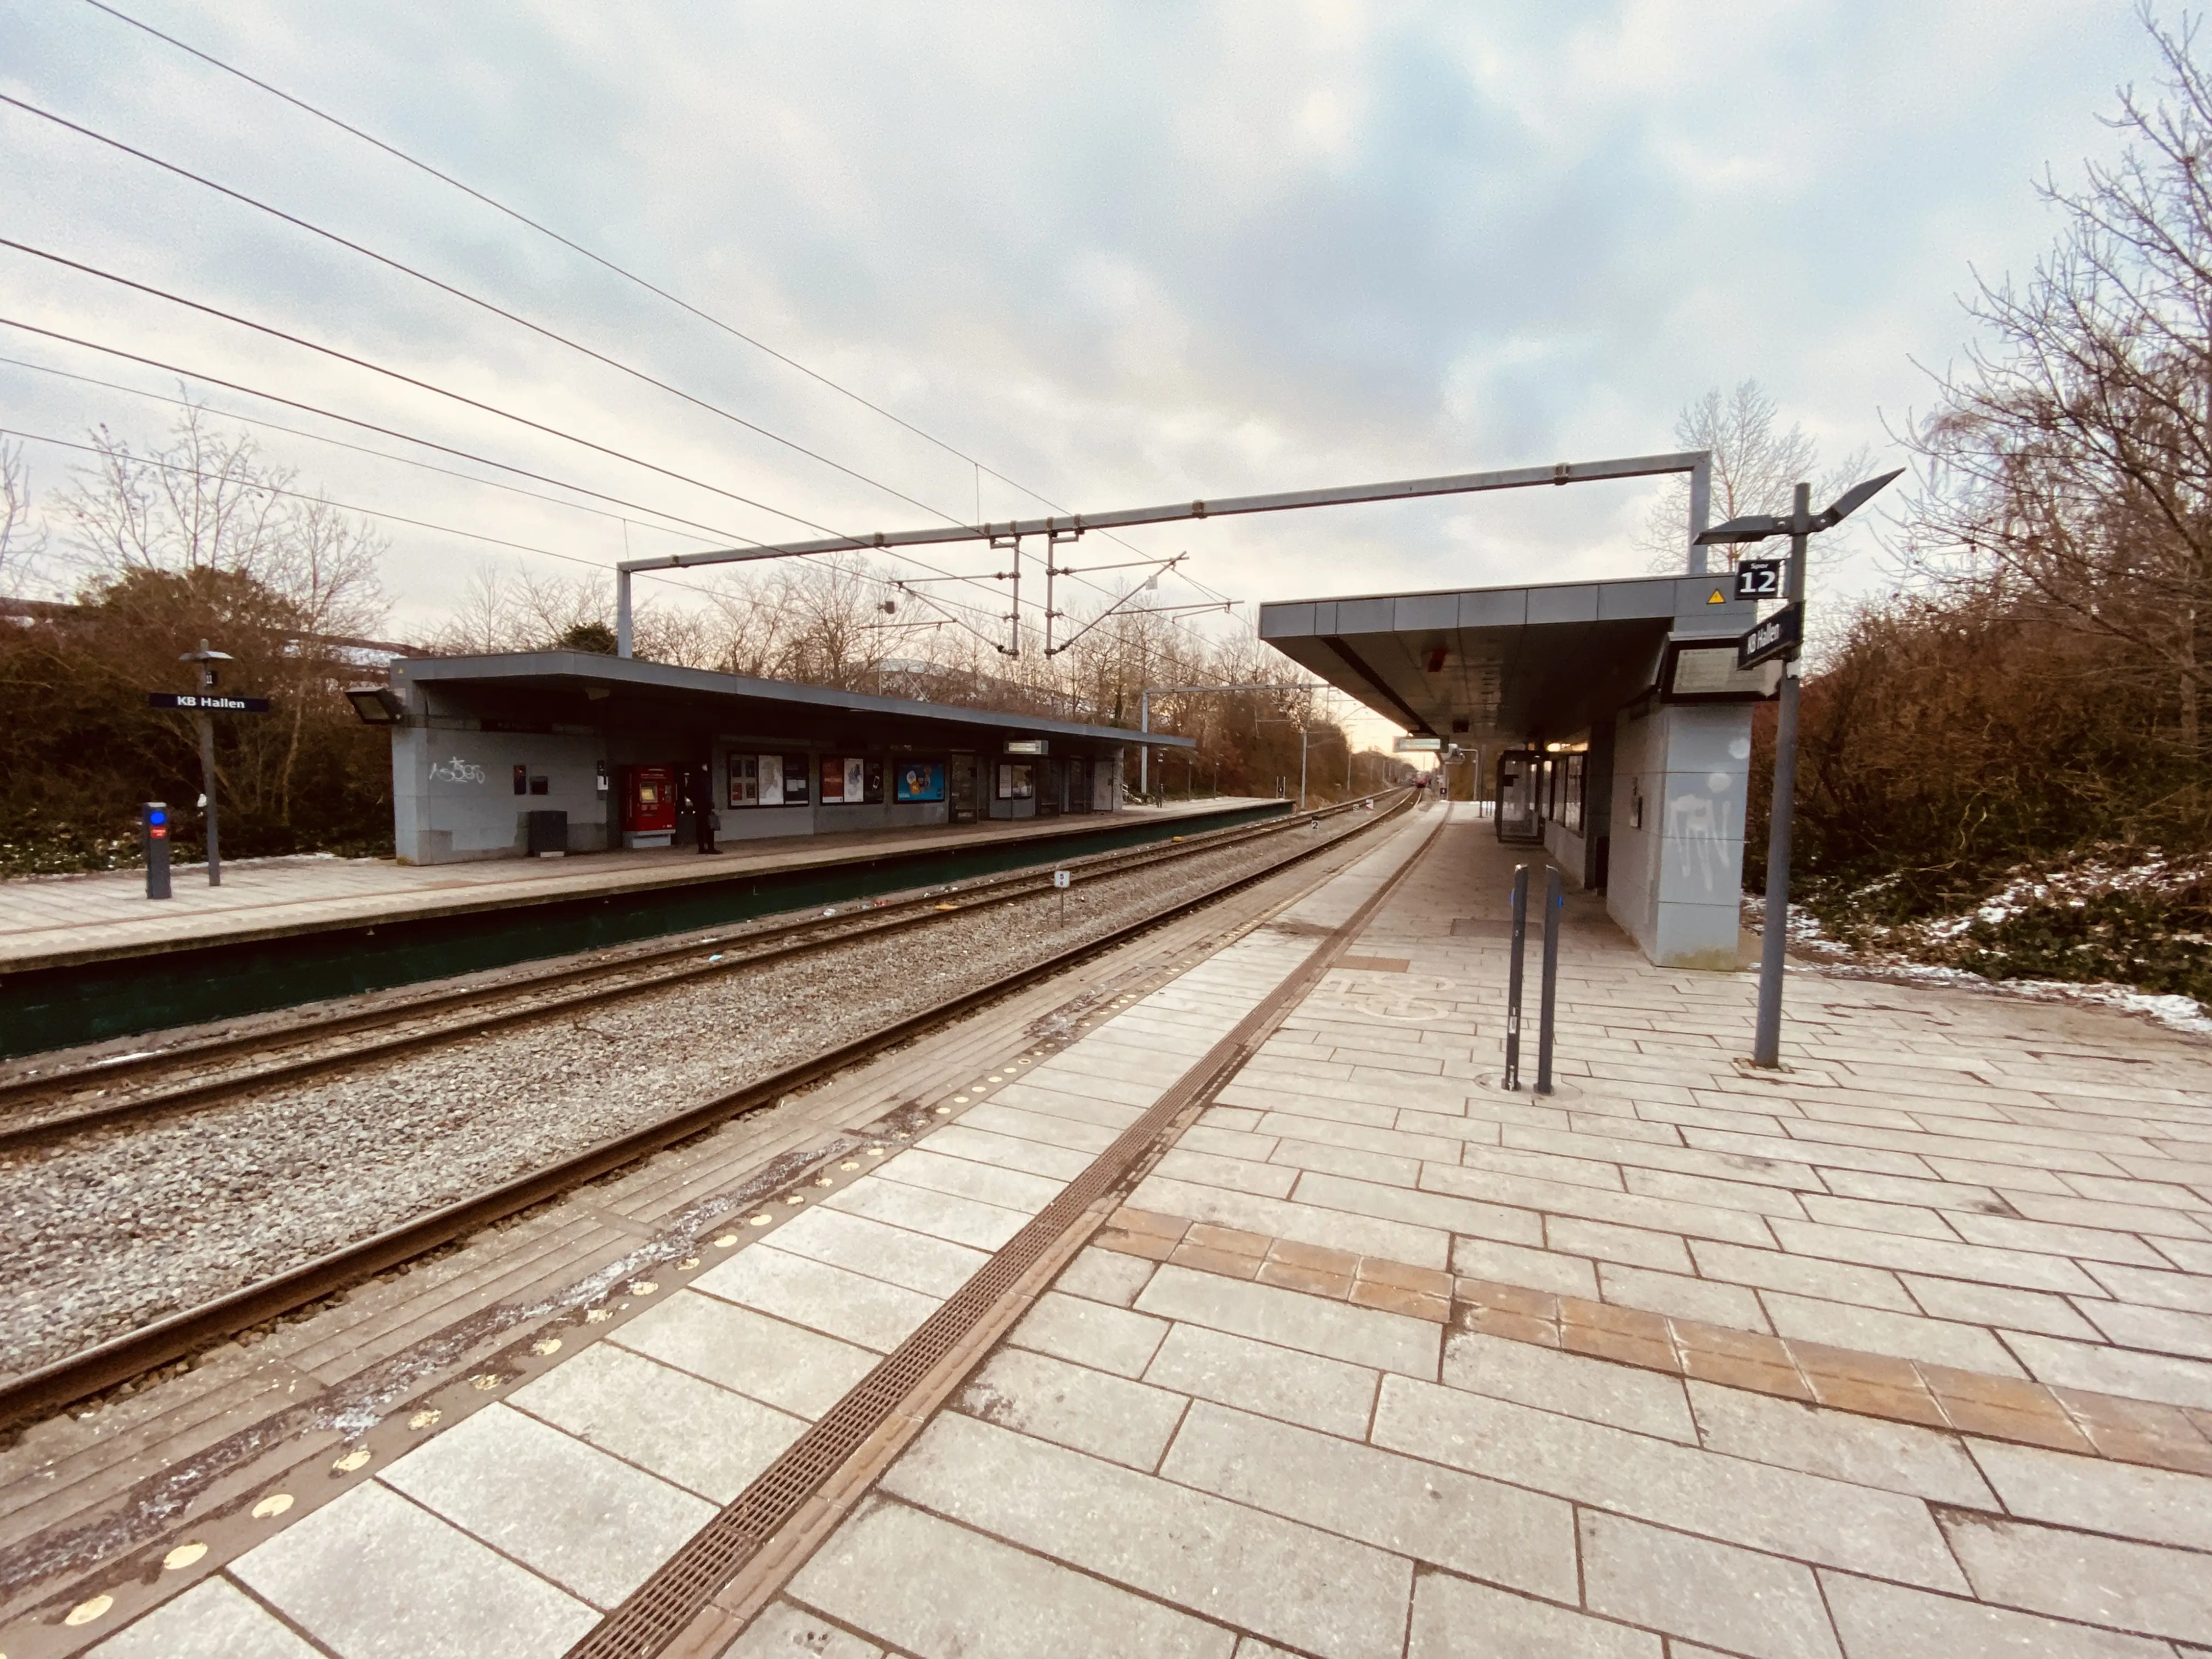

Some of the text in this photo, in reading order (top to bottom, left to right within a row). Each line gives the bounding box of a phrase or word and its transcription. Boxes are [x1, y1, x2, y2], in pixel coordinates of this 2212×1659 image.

[1740, 571, 1775, 592] 12
[177, 696, 245, 708] KB Hallen
